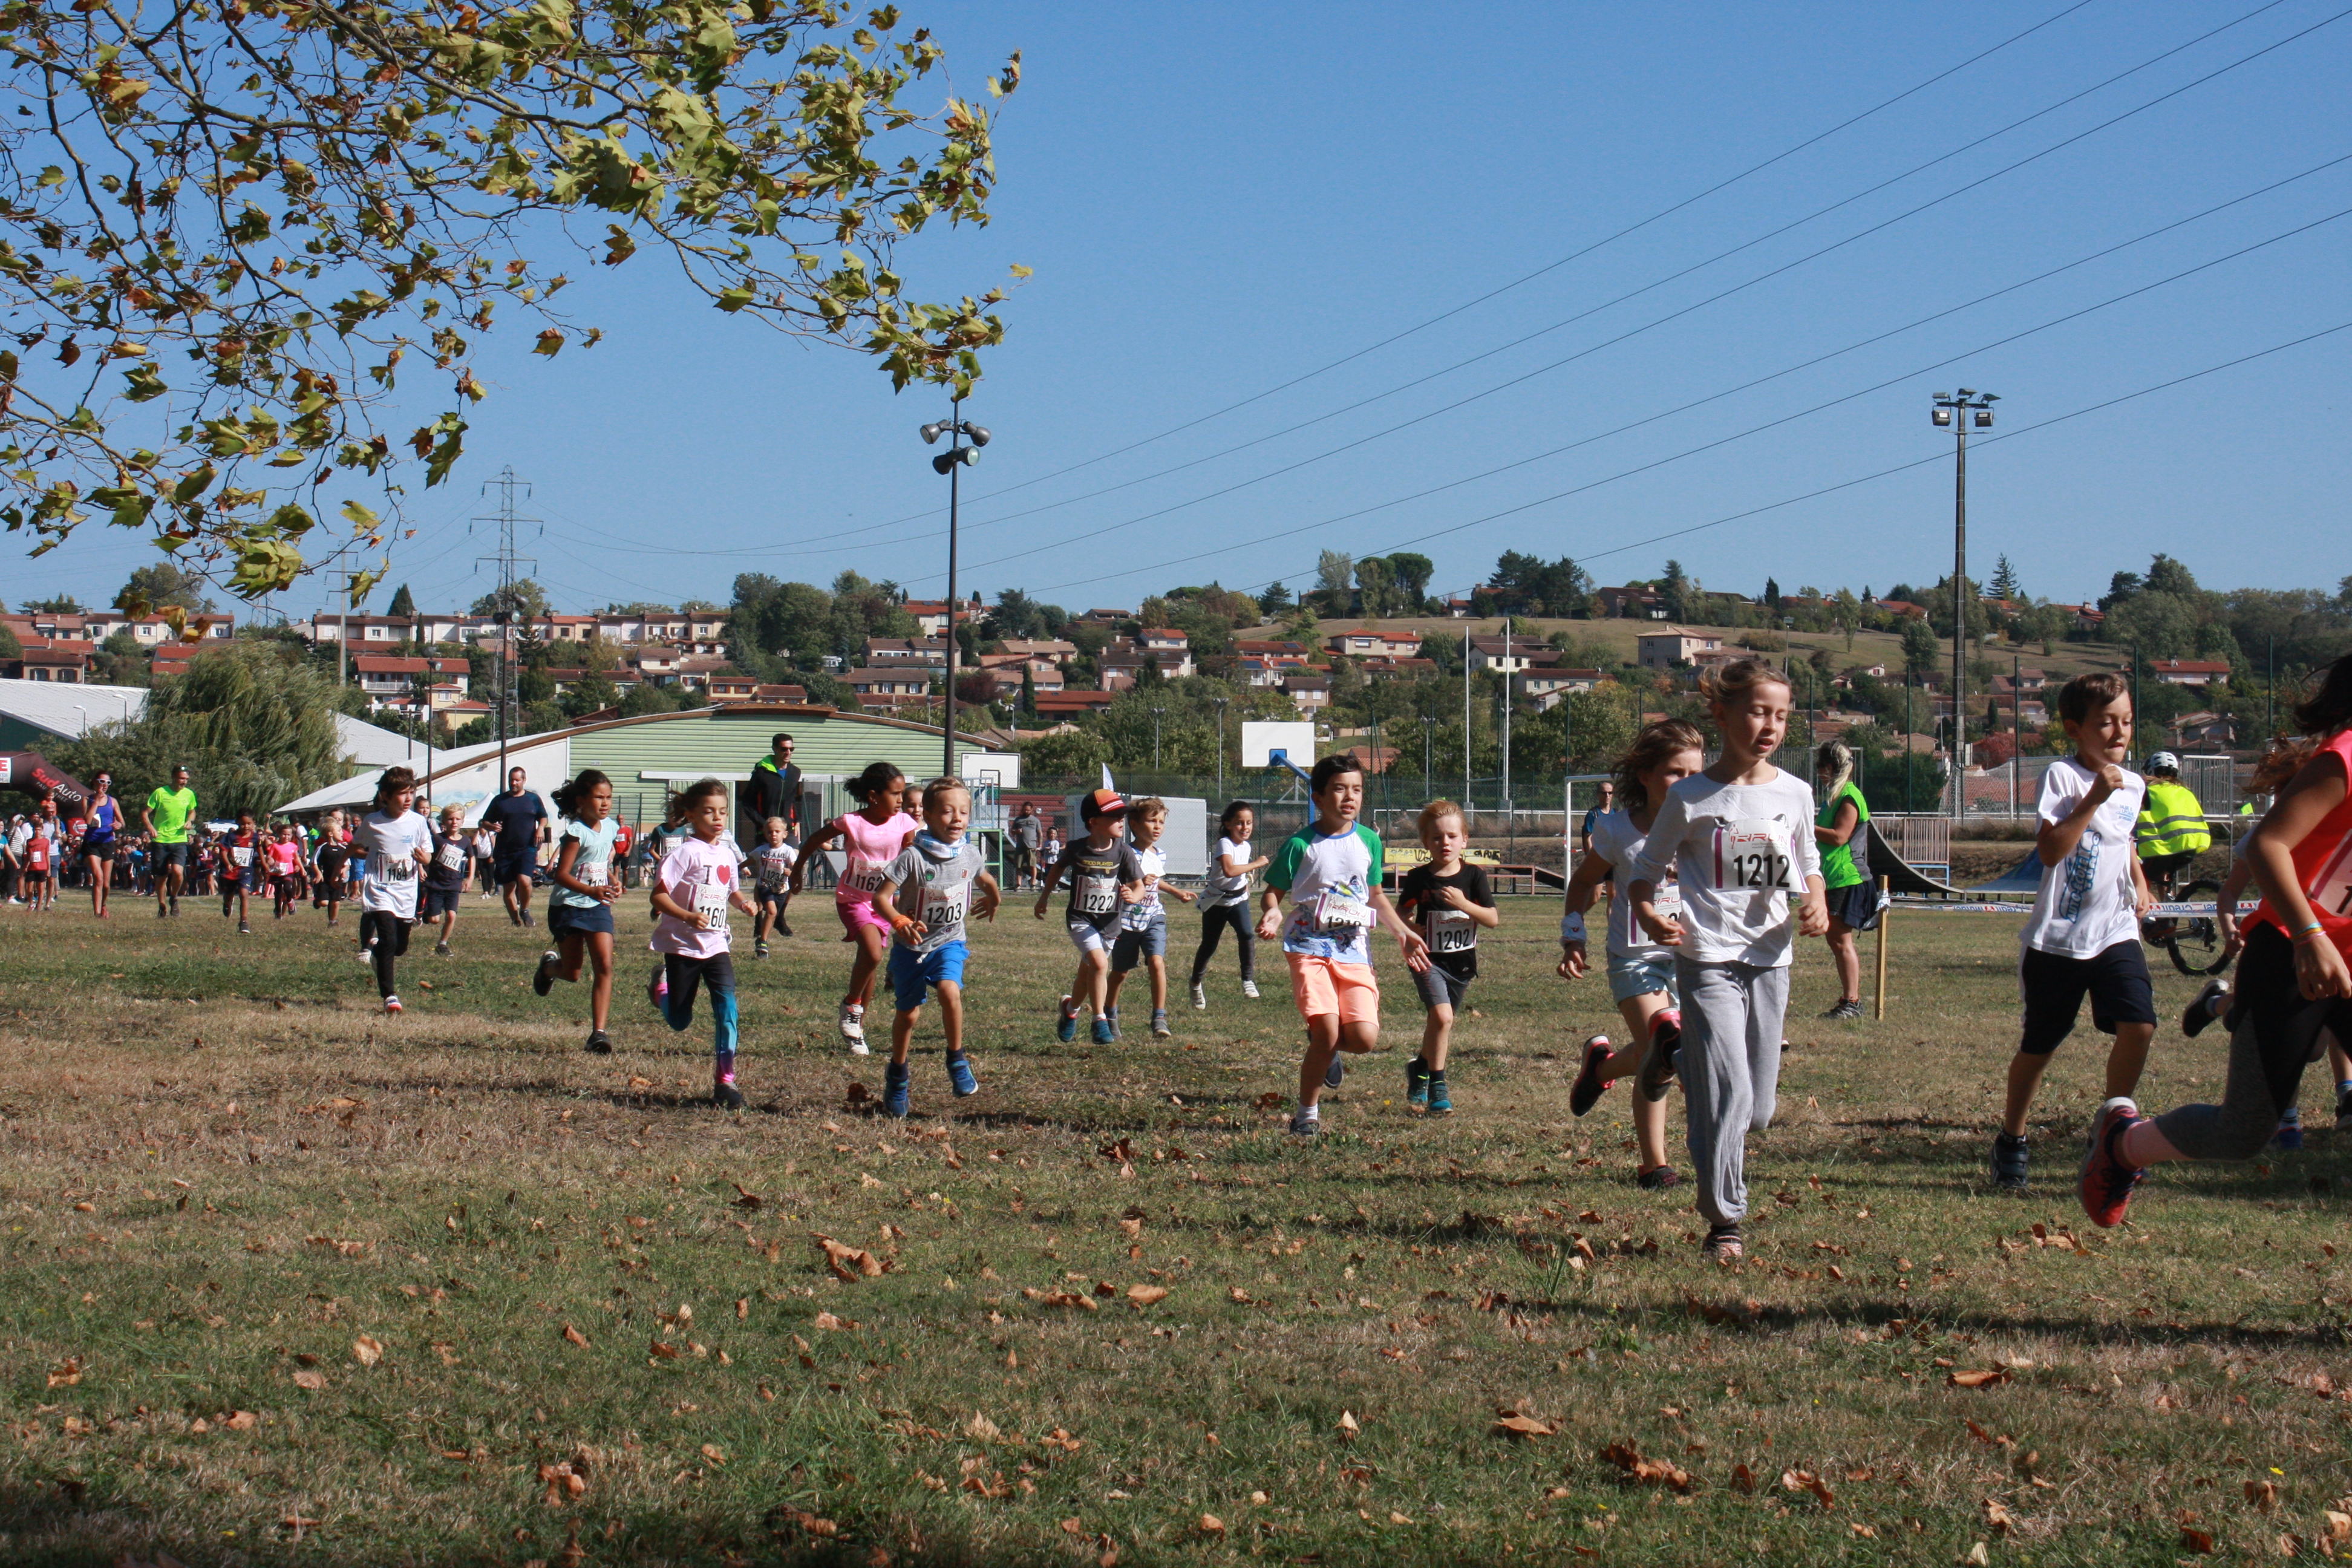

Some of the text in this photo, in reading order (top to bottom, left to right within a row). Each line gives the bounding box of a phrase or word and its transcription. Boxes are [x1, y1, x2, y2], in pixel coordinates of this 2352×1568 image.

[443, 855, 459, 868] 1174
[1734, 854, 1789, 887] 1212
[387, 867, 408, 881] 1184
[703, 865, 713, 885] I
[767, 870, 785, 882] 1232
[855, 874, 883, 892] 1162
[1083, 893, 1113, 911] 1222
[927, 903, 962, 923] 1203
[1436, 929, 1469, 950] 1202
